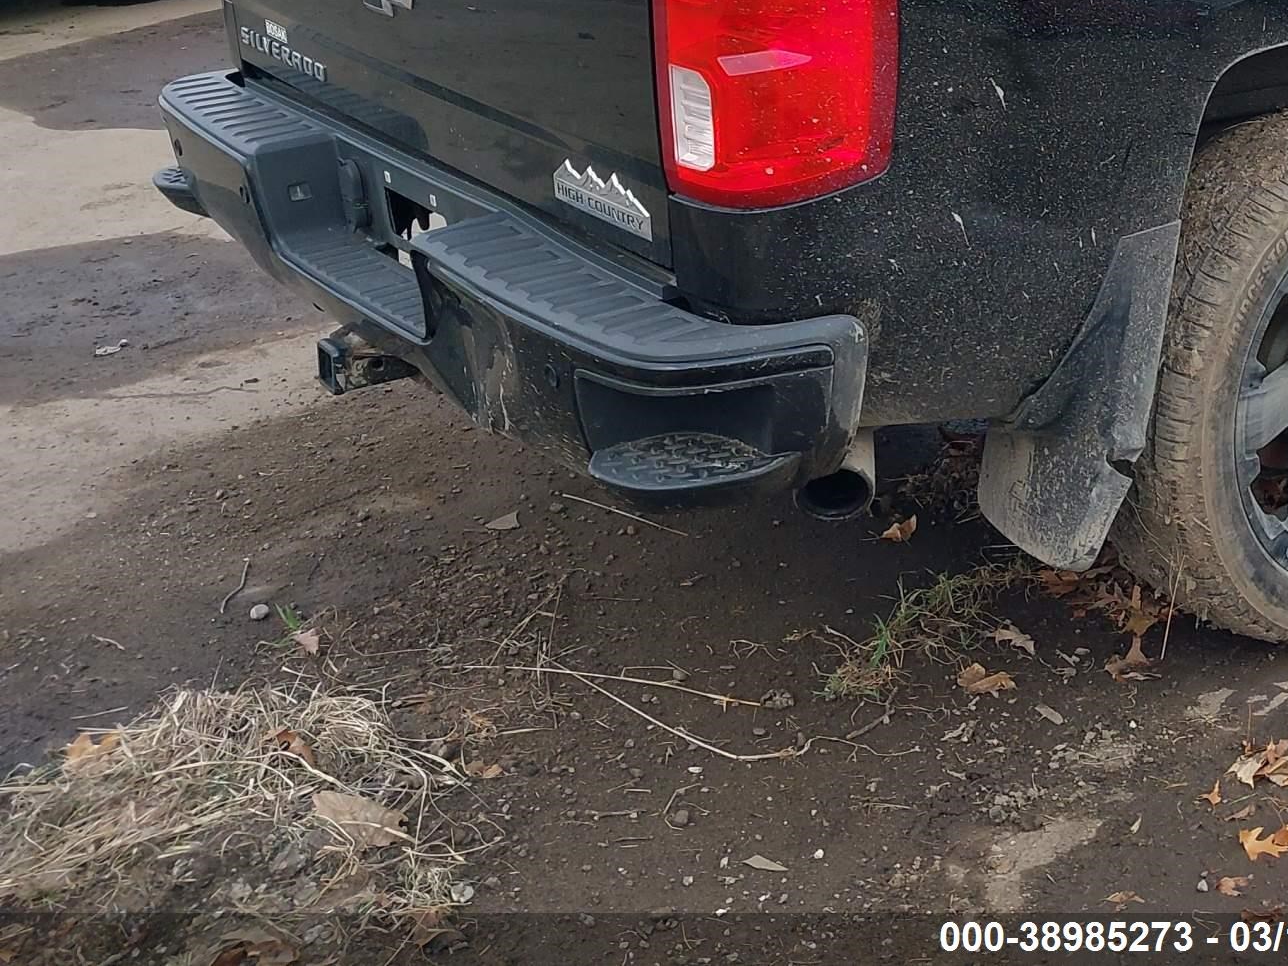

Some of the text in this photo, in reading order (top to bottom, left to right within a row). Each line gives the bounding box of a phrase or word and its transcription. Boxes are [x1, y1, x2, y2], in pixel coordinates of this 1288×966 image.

[241, 26, 328, 83] SILVERADO
[557, 181, 645, 231] HIGH COUNTRY
